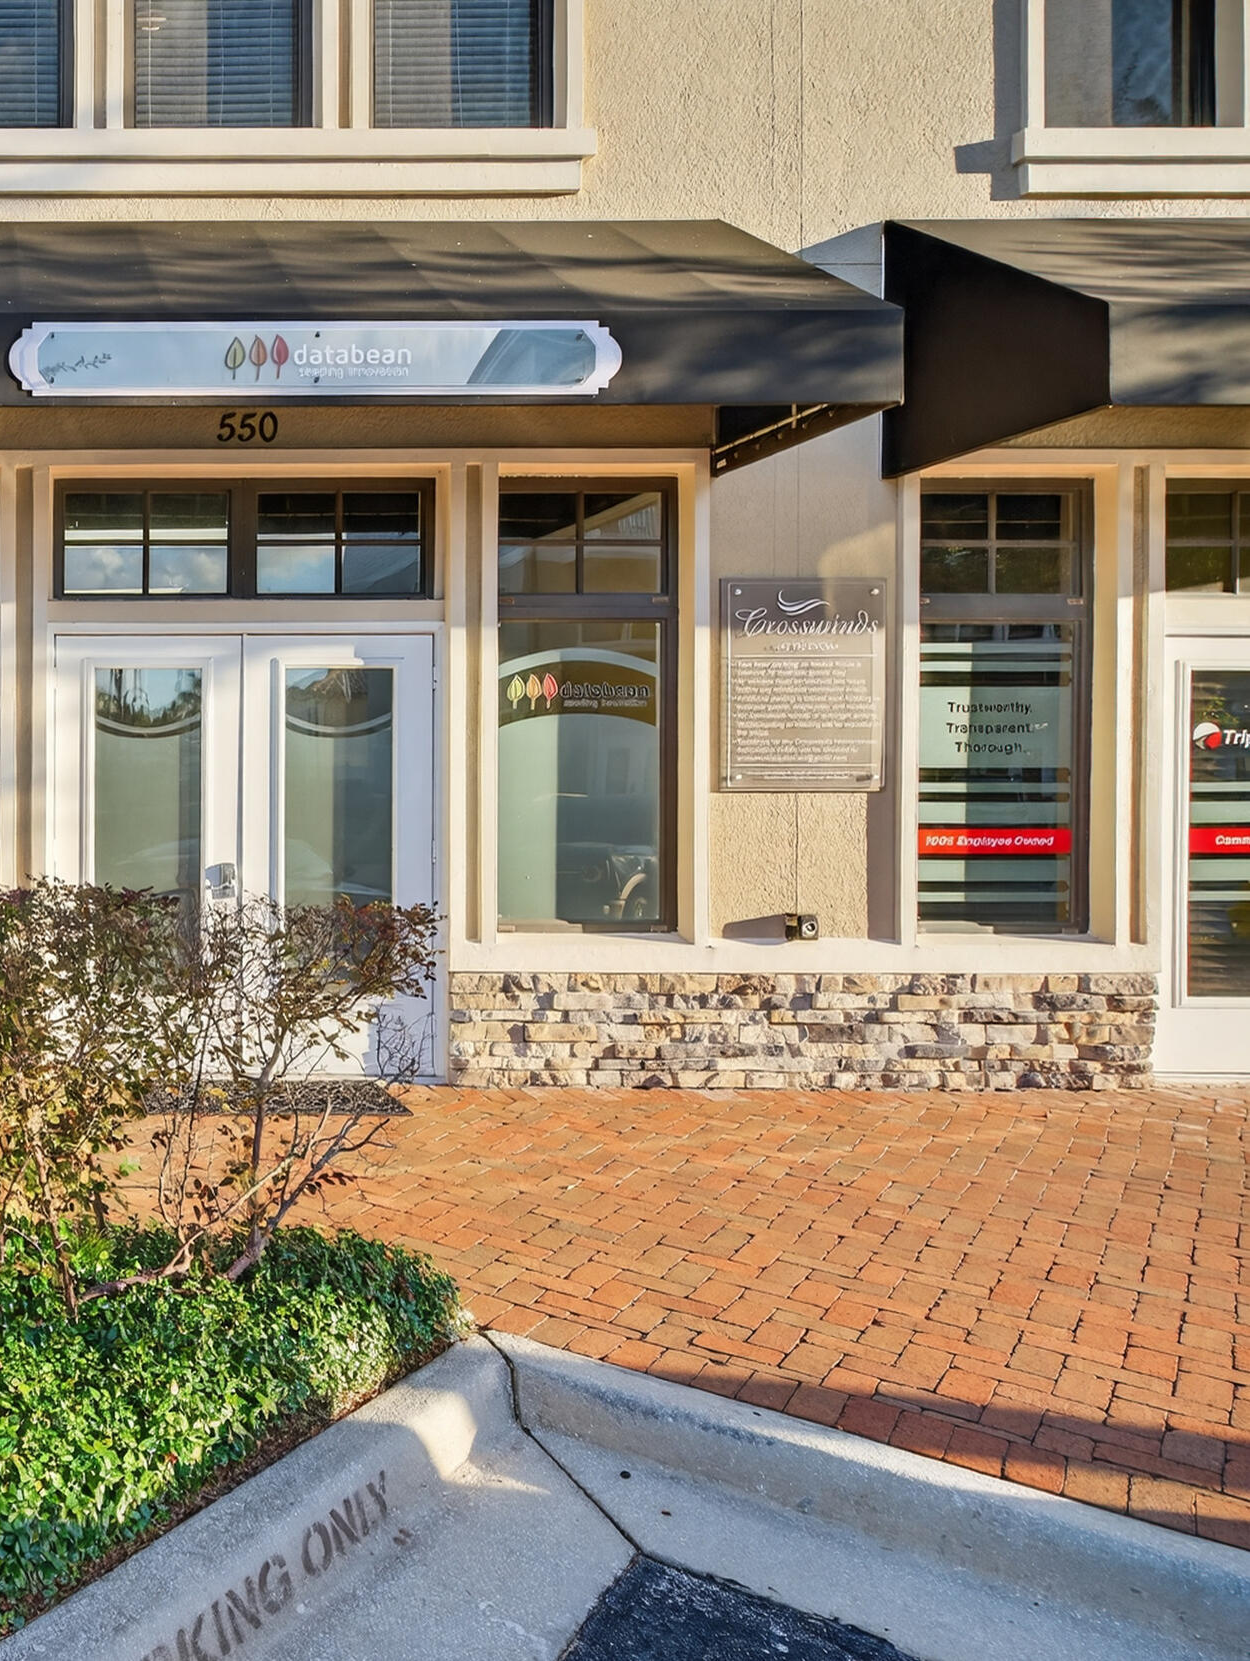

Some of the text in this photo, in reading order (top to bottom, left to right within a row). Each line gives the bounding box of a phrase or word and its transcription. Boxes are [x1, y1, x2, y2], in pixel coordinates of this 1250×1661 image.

[293, 343, 412, 365] databean
[216, 411, 278, 443] 550
[735, 607, 879, 637] Crosswinds
[956, 835, 1012, 848] Employee
[1014, 835, 1055, 847] Owned
[301, 1469, 388, 1578] ONLY
